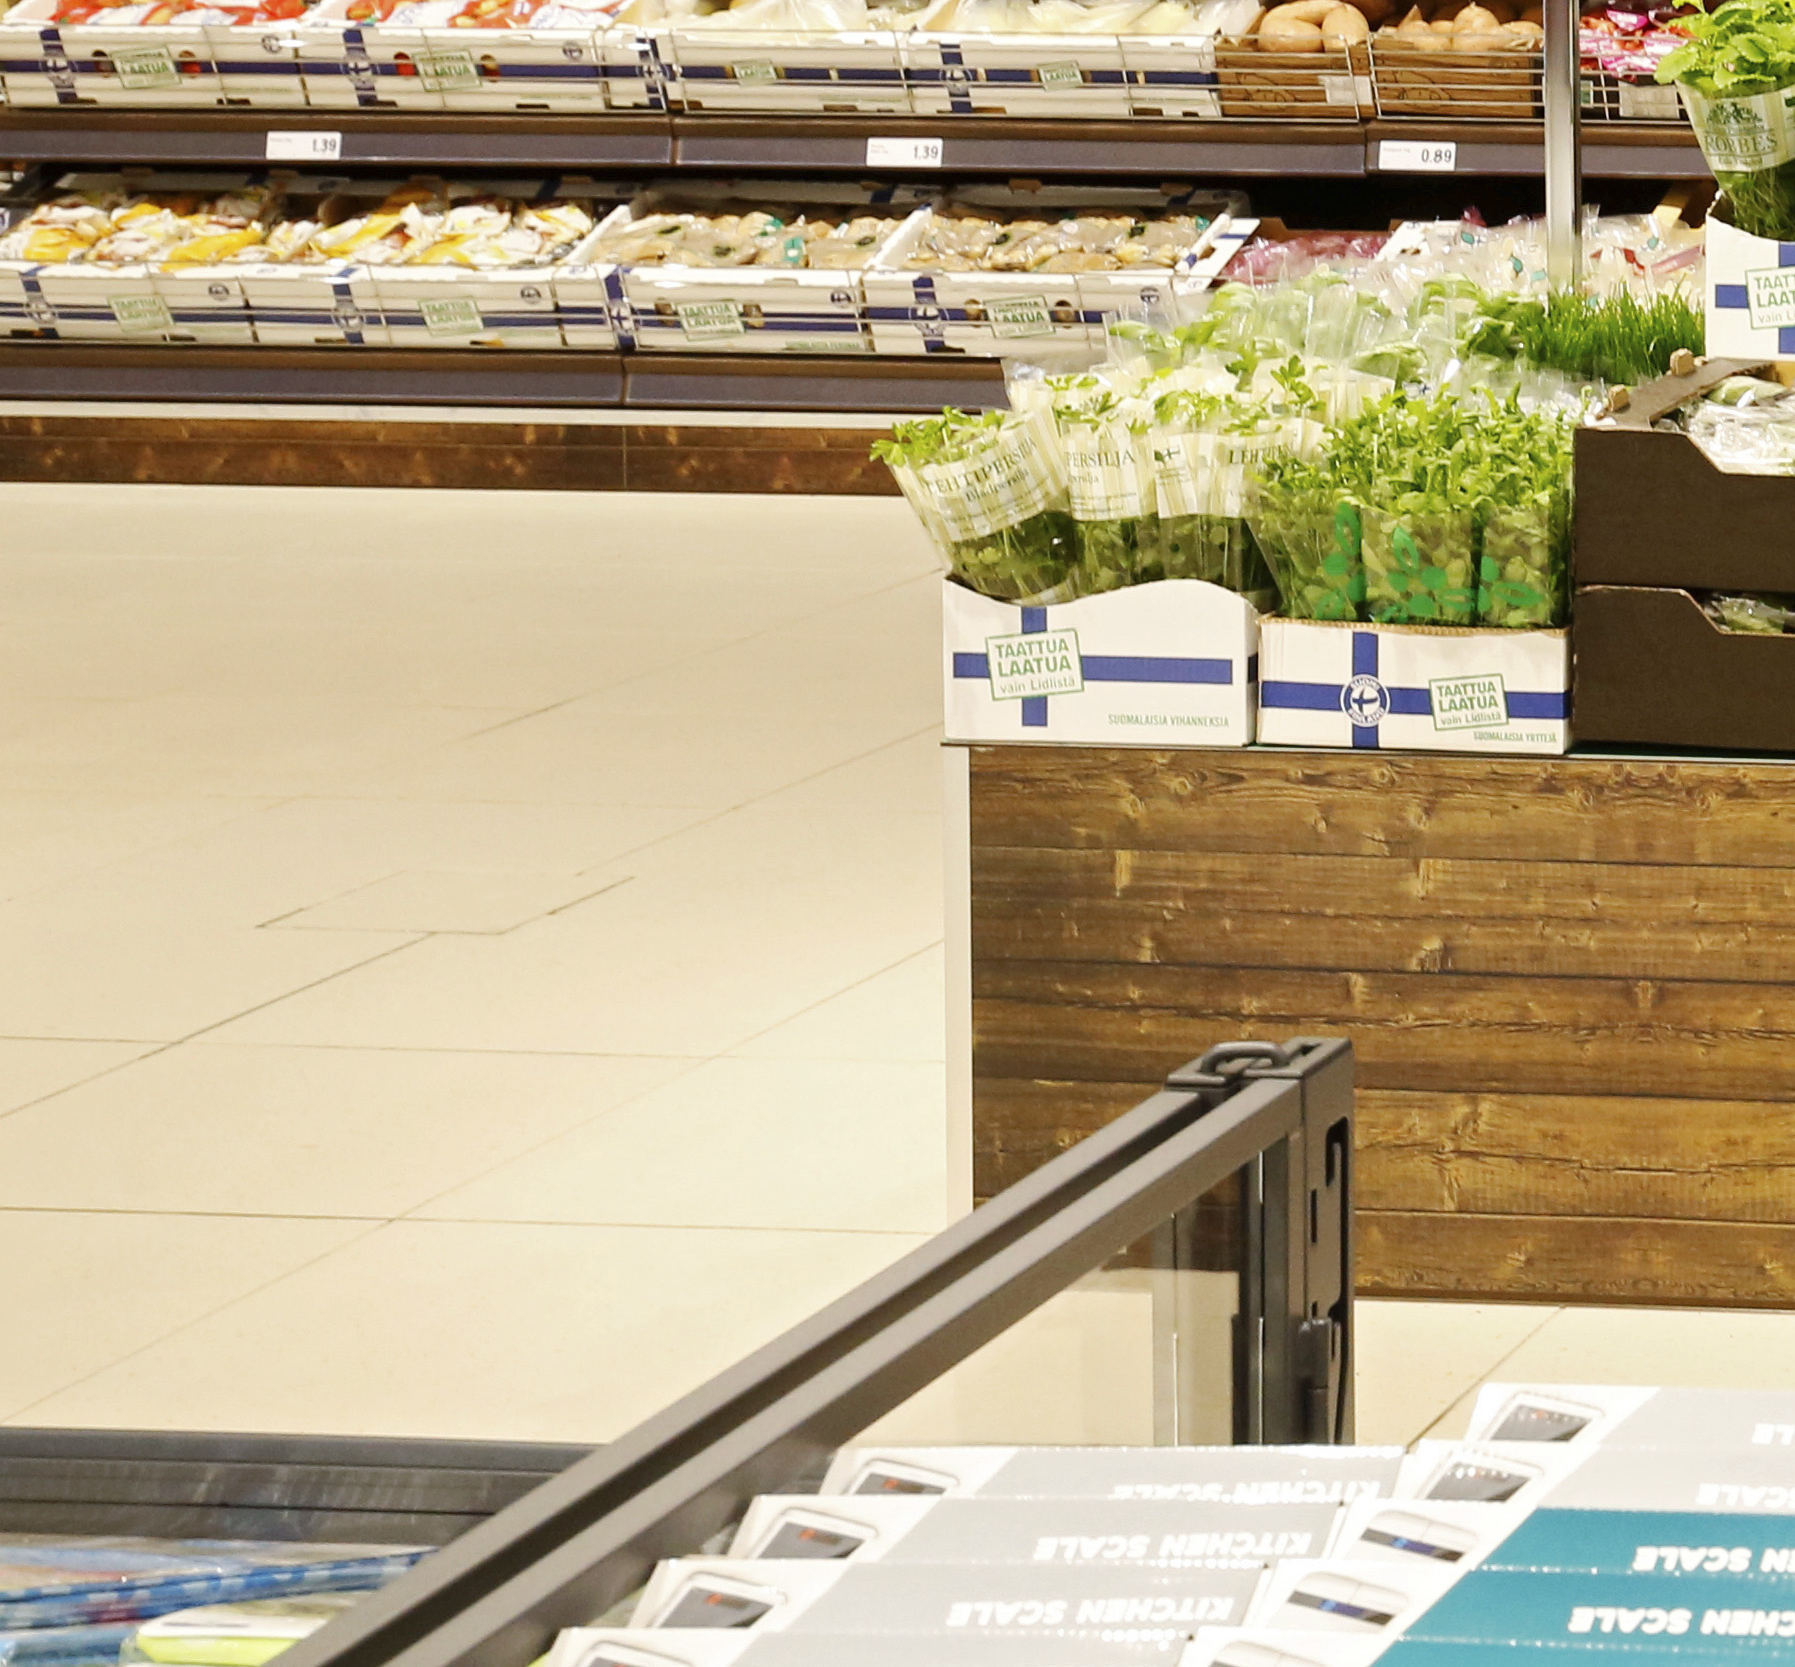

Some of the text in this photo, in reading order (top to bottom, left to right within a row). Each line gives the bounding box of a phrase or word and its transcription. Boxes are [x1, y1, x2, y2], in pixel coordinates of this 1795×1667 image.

[912, 145, 940, 161] 1.39
[1421, 149, 1453, 165] 0.89
[1758, 311, 1783, 324] vain
[995, 638, 1069, 659] TAATTUA
[998, 656, 1072, 677] LAATUA
[1000, 677, 1075, 694] vain Lidlistä
[1437, 681, 1496, 698] TAATTUA
[1439, 695, 1498, 713] LAATUA
[1108, 714, 1229, 727] SUOMALAISIA VIHANNEKSIA
[1441, 712, 1501, 725] vain Lidlistä
